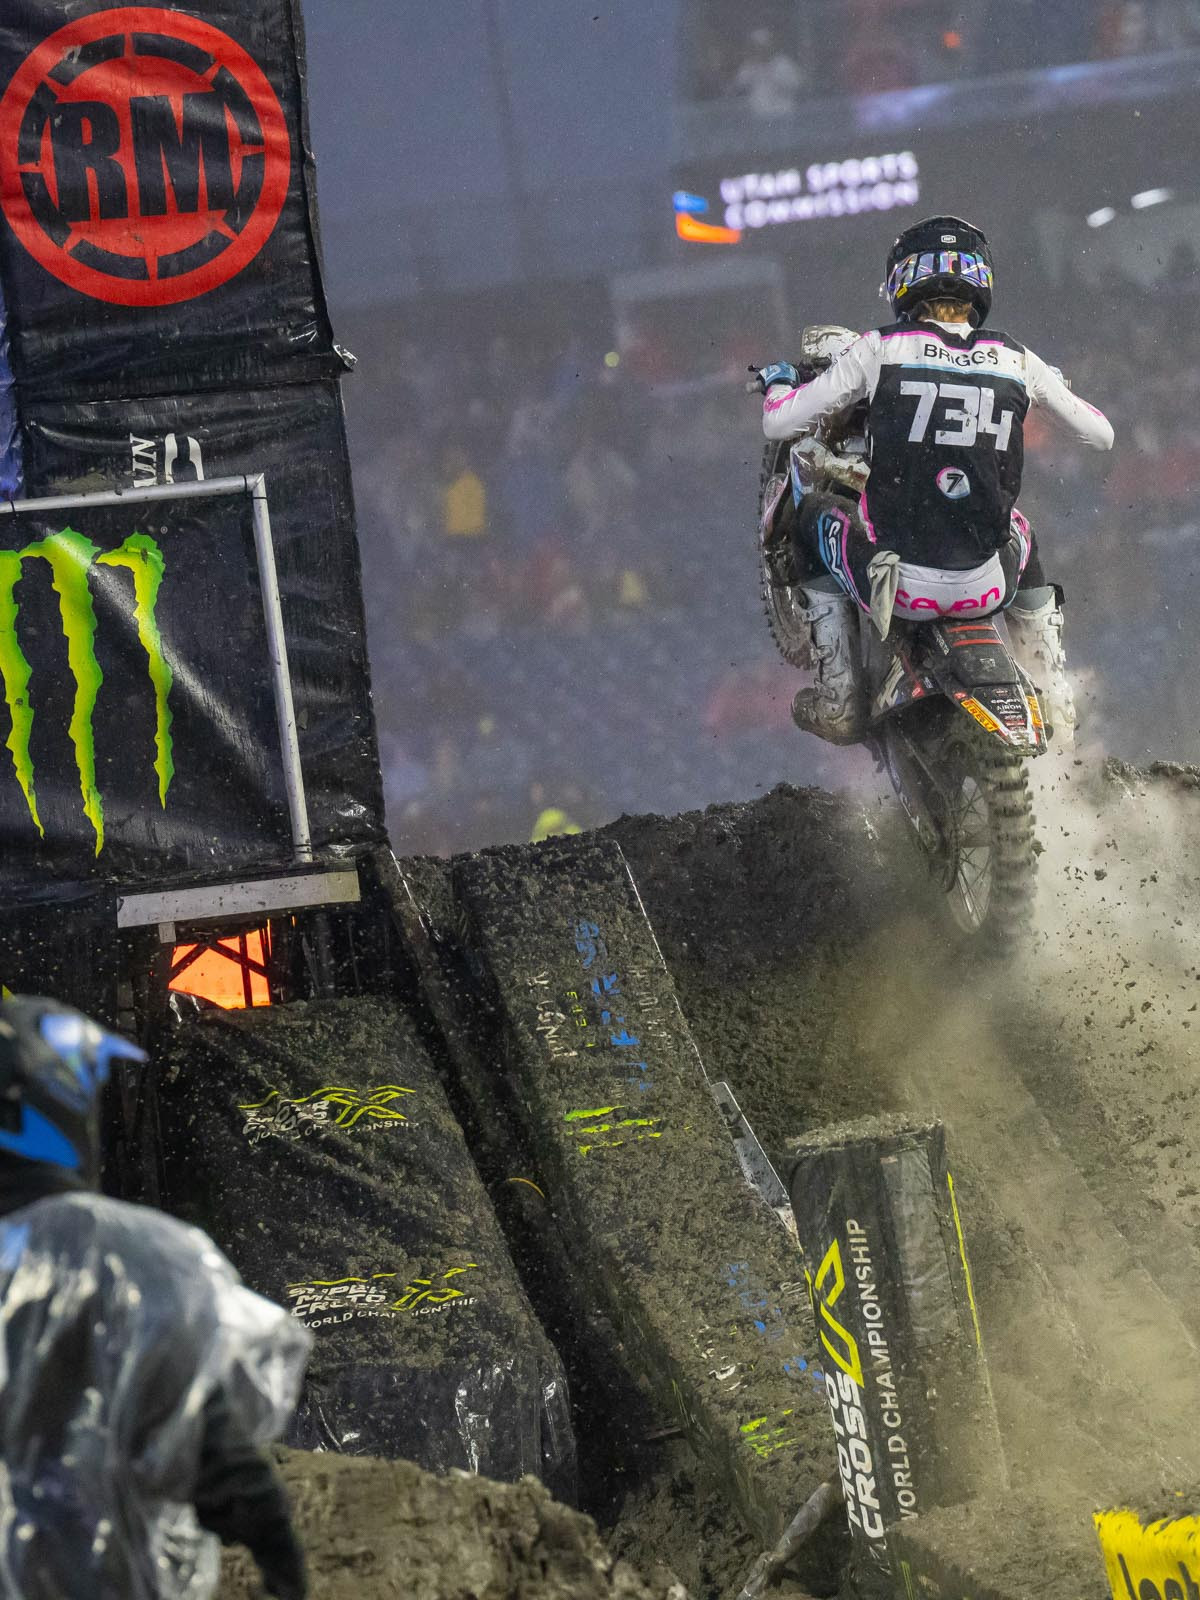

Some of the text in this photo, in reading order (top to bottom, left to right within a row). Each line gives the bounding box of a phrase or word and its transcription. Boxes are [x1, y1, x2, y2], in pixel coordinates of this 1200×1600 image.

[49, 92, 231, 221] RM
[924, 343, 999, 367] BRIGGS
[900, 381, 1014, 451] 734
[895, 587, 1000, 616] seven
[289, 1284, 388, 1298] SPER
[356, 1297, 479, 1319] CHAIONSHIP
[846, 1219, 902, 1428] CHAMPIONSHIP
[836, 1370, 884, 1539] CROSS
